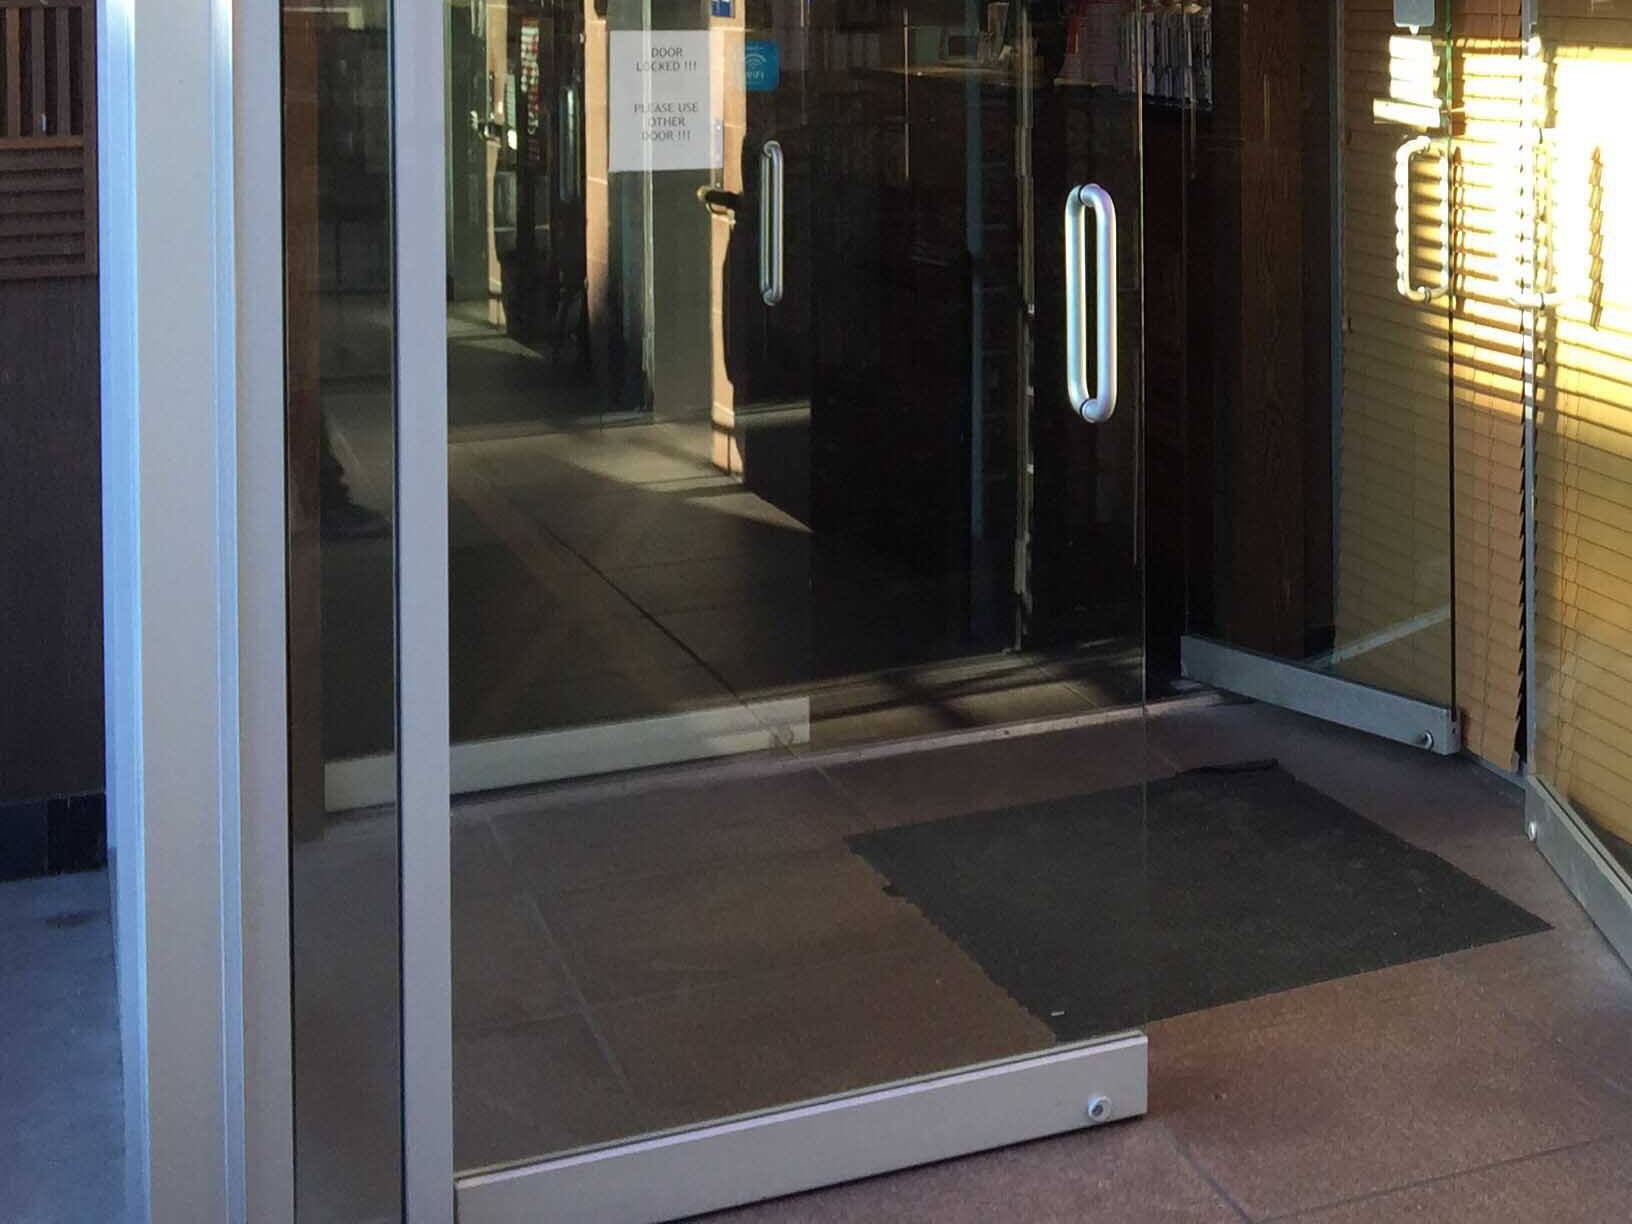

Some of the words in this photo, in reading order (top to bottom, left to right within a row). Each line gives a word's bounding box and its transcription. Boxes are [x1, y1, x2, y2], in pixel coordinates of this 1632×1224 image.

[651, 47, 683, 57] DOOR
[678, 103, 698, 113] USE
[648, 117, 686, 128] OTHER
[640, 131, 674, 142] DOOR
